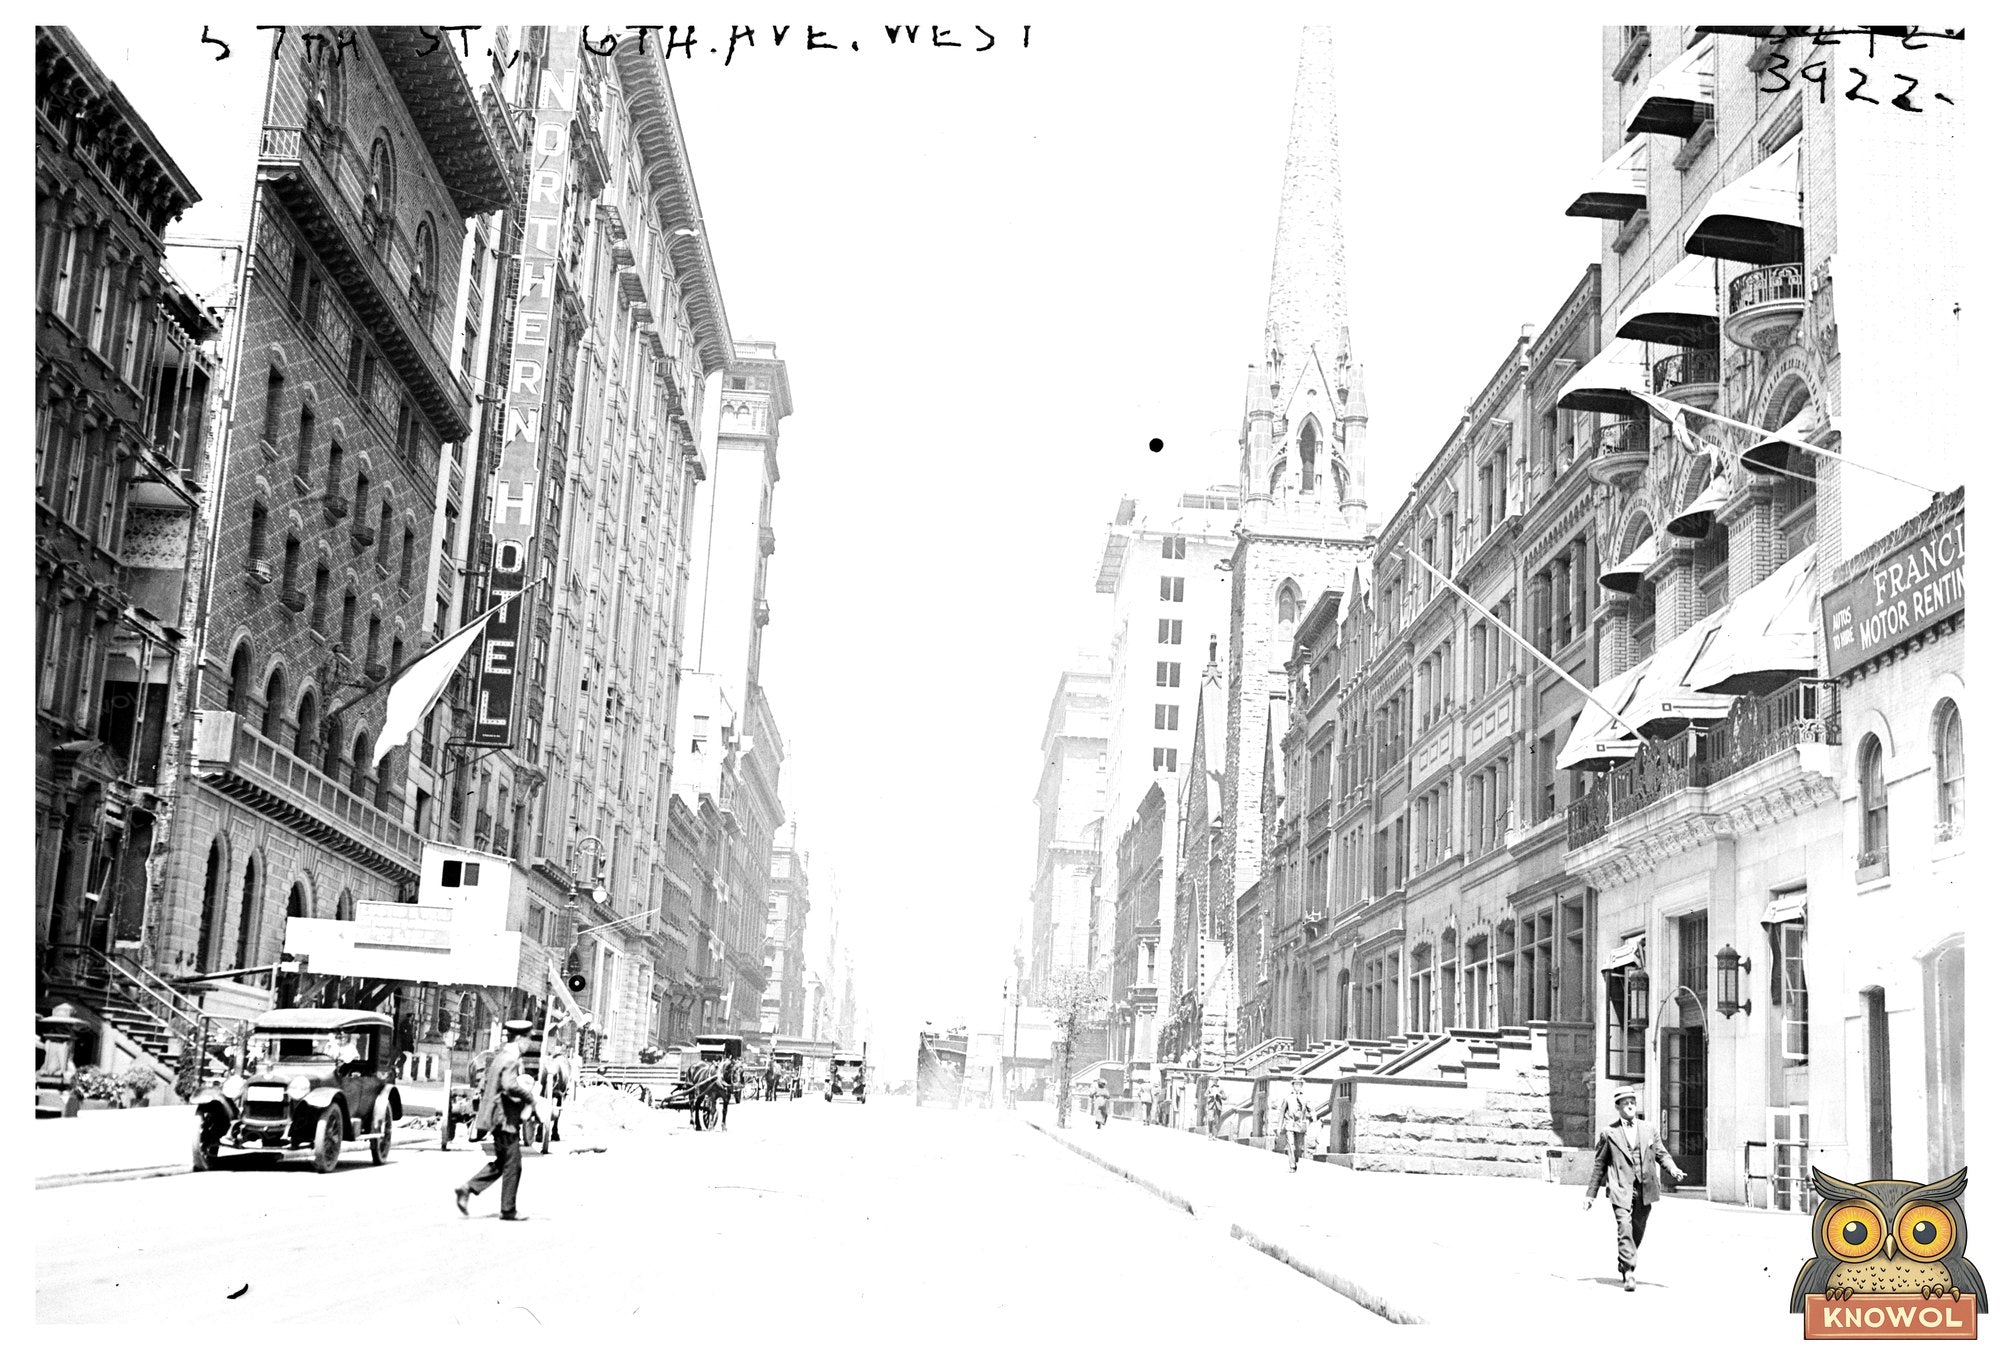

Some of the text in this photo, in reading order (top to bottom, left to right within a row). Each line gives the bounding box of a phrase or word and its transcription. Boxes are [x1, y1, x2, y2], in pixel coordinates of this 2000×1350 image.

[479, 69, 576, 725] NORTHERN HOTEL
[1832, 634, 1841, 652] TO
[1859, 600, 1909, 650] MOTOR
